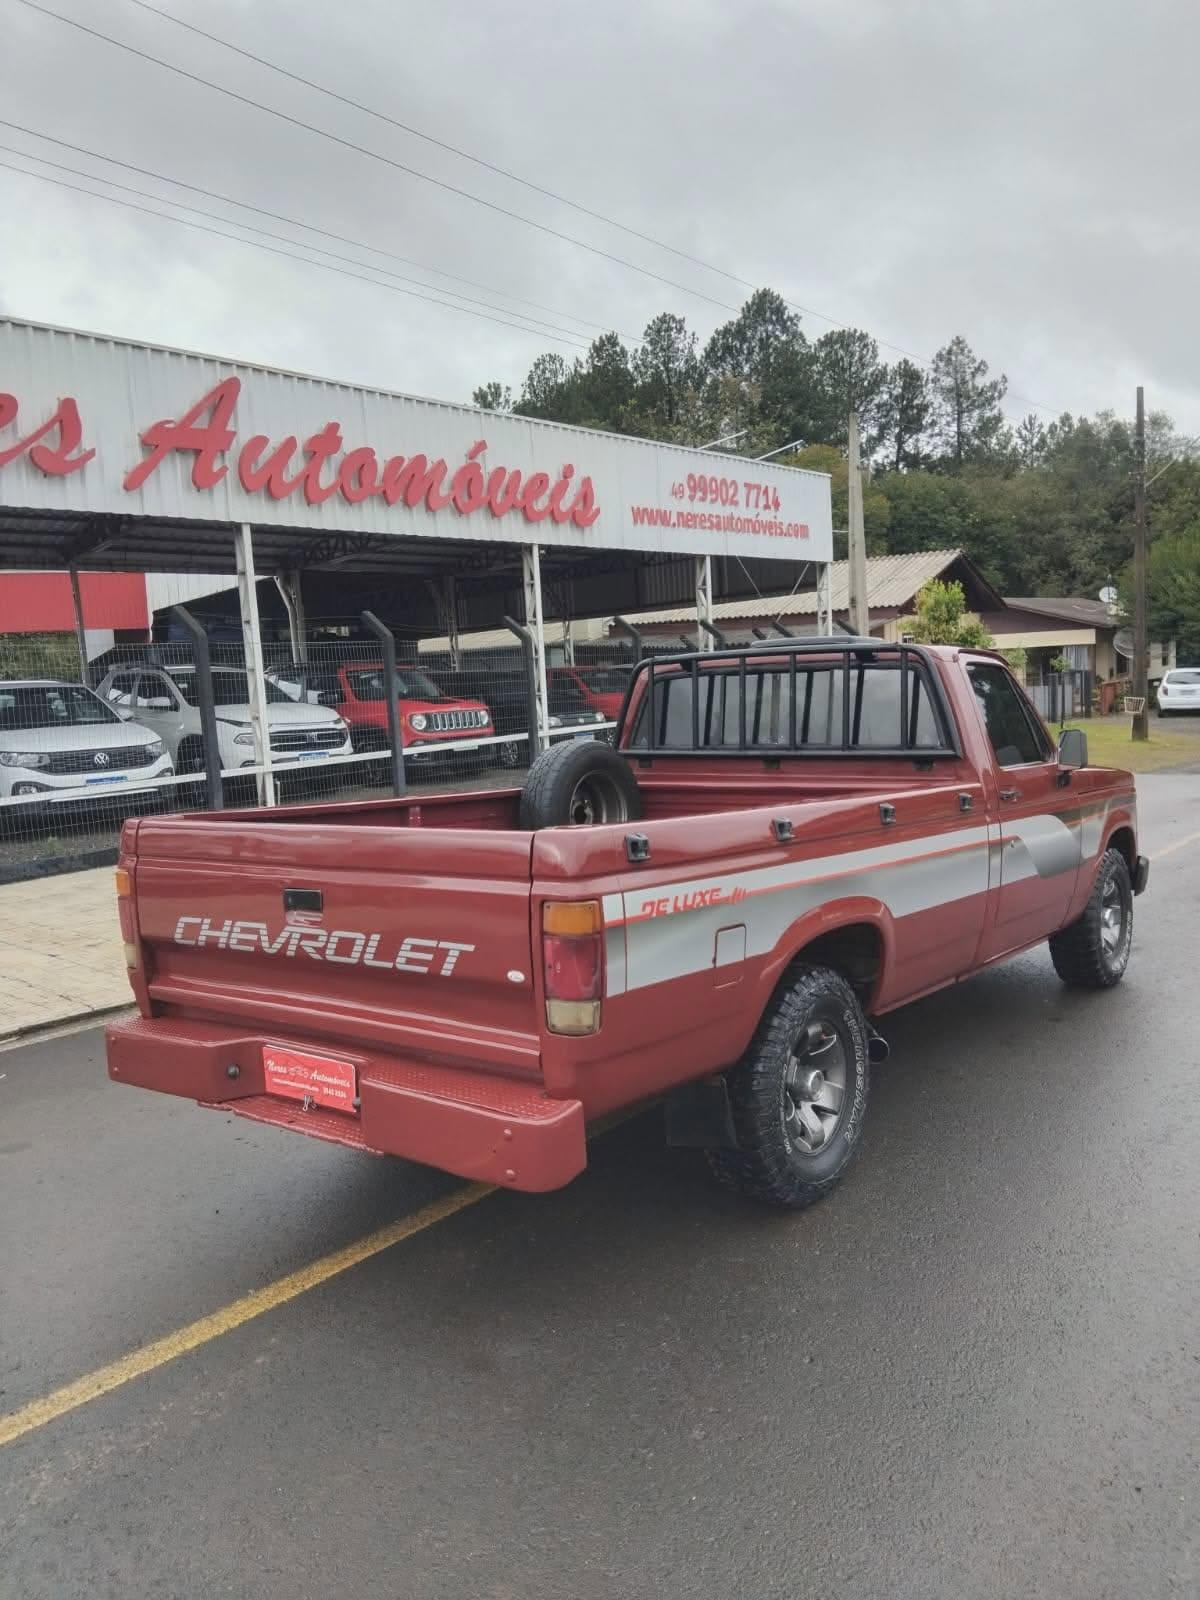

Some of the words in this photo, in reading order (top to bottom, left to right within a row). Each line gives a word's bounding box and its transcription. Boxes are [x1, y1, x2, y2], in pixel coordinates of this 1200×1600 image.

[123, 376, 601, 528] Automóveis
[671, 481, 684, 498] 49
[687, 473, 739, 506] 99902
[744, 483, 780, 512] 7714
[631, 504, 809, 539] www.neresautomóveis.com
[642, 899, 670, 916] DE
[673, 887, 721, 913] LUXE
[174, 916, 475, 976] CHEVROLET
